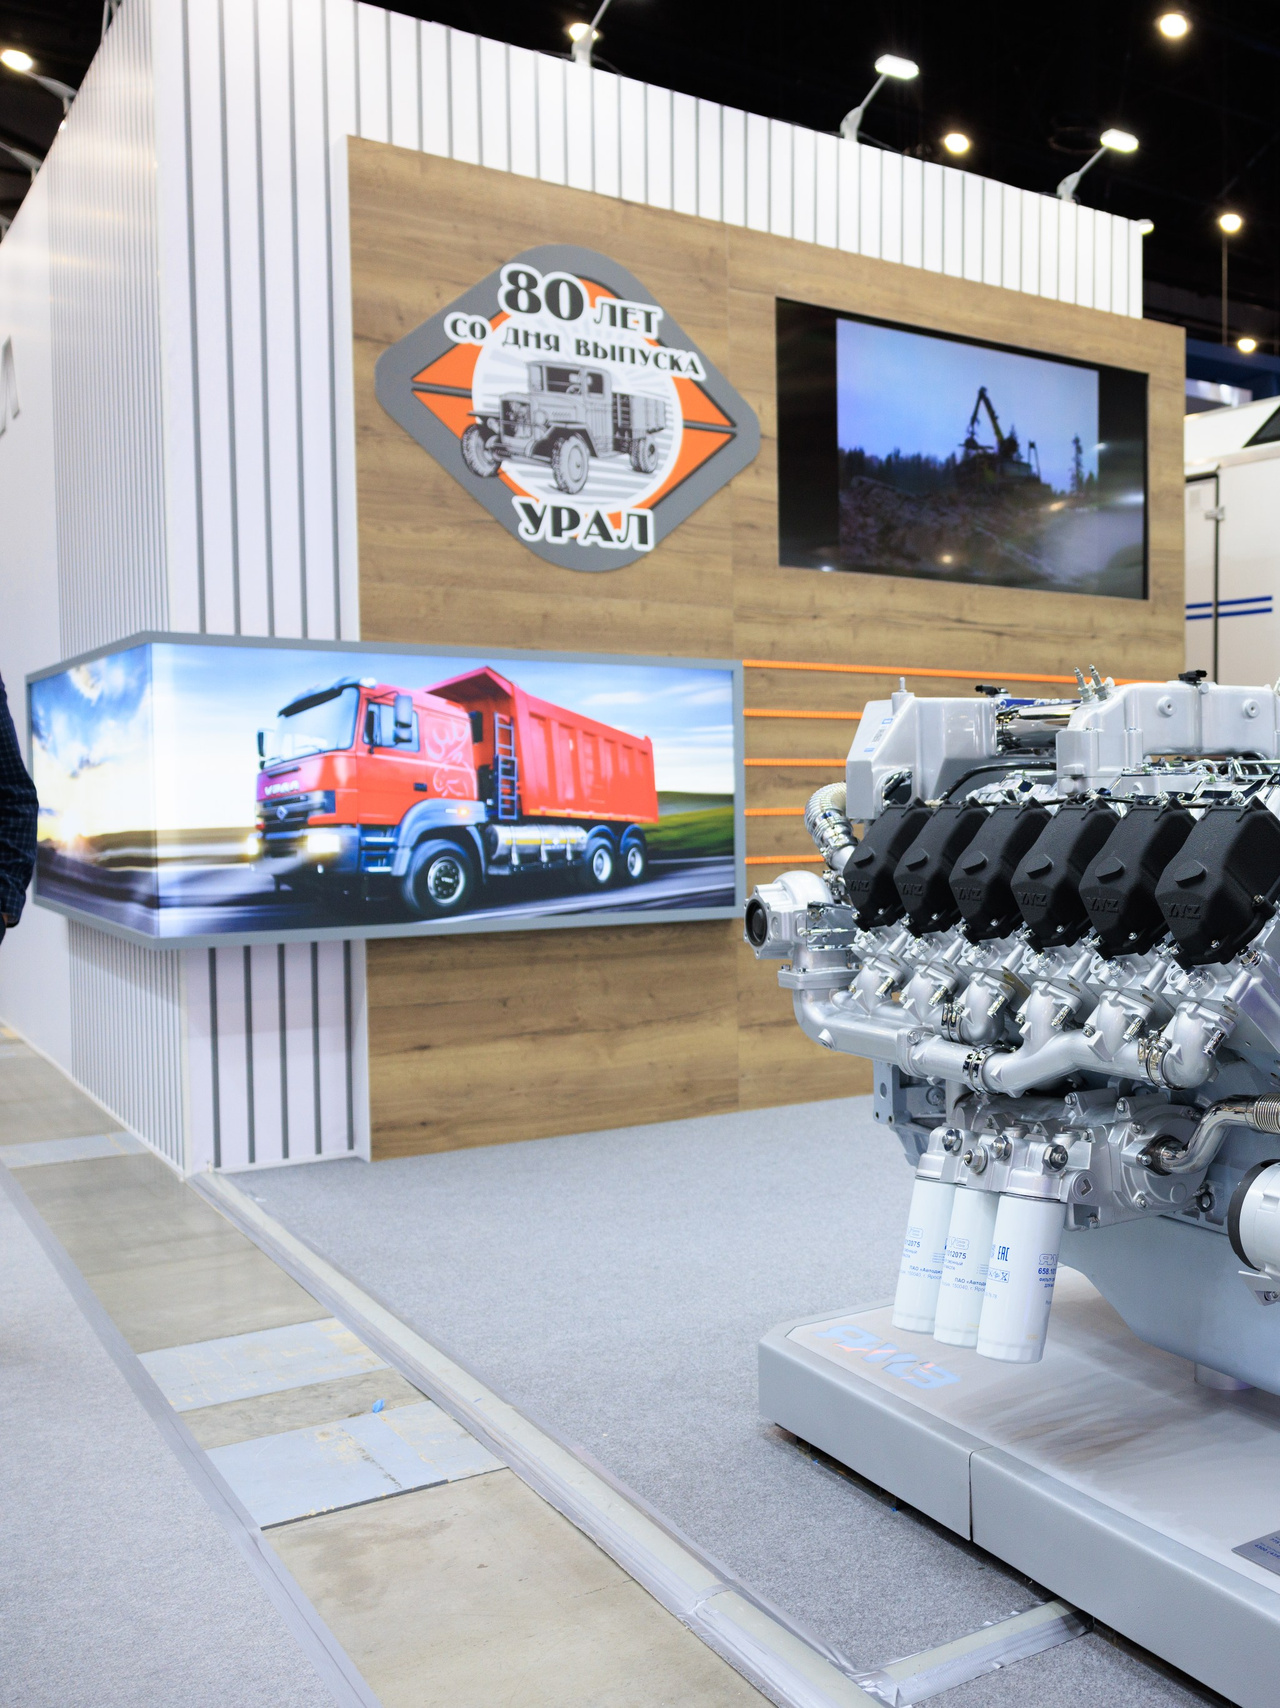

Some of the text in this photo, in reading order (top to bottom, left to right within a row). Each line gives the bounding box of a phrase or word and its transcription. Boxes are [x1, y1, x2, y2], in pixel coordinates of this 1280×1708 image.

[502, 269, 659, 335] 80 ЛЕТ
[450, 318, 700, 376] СО ДНЯ ВЫПУСКА
[518, 501, 650, 546] УРАЛ
